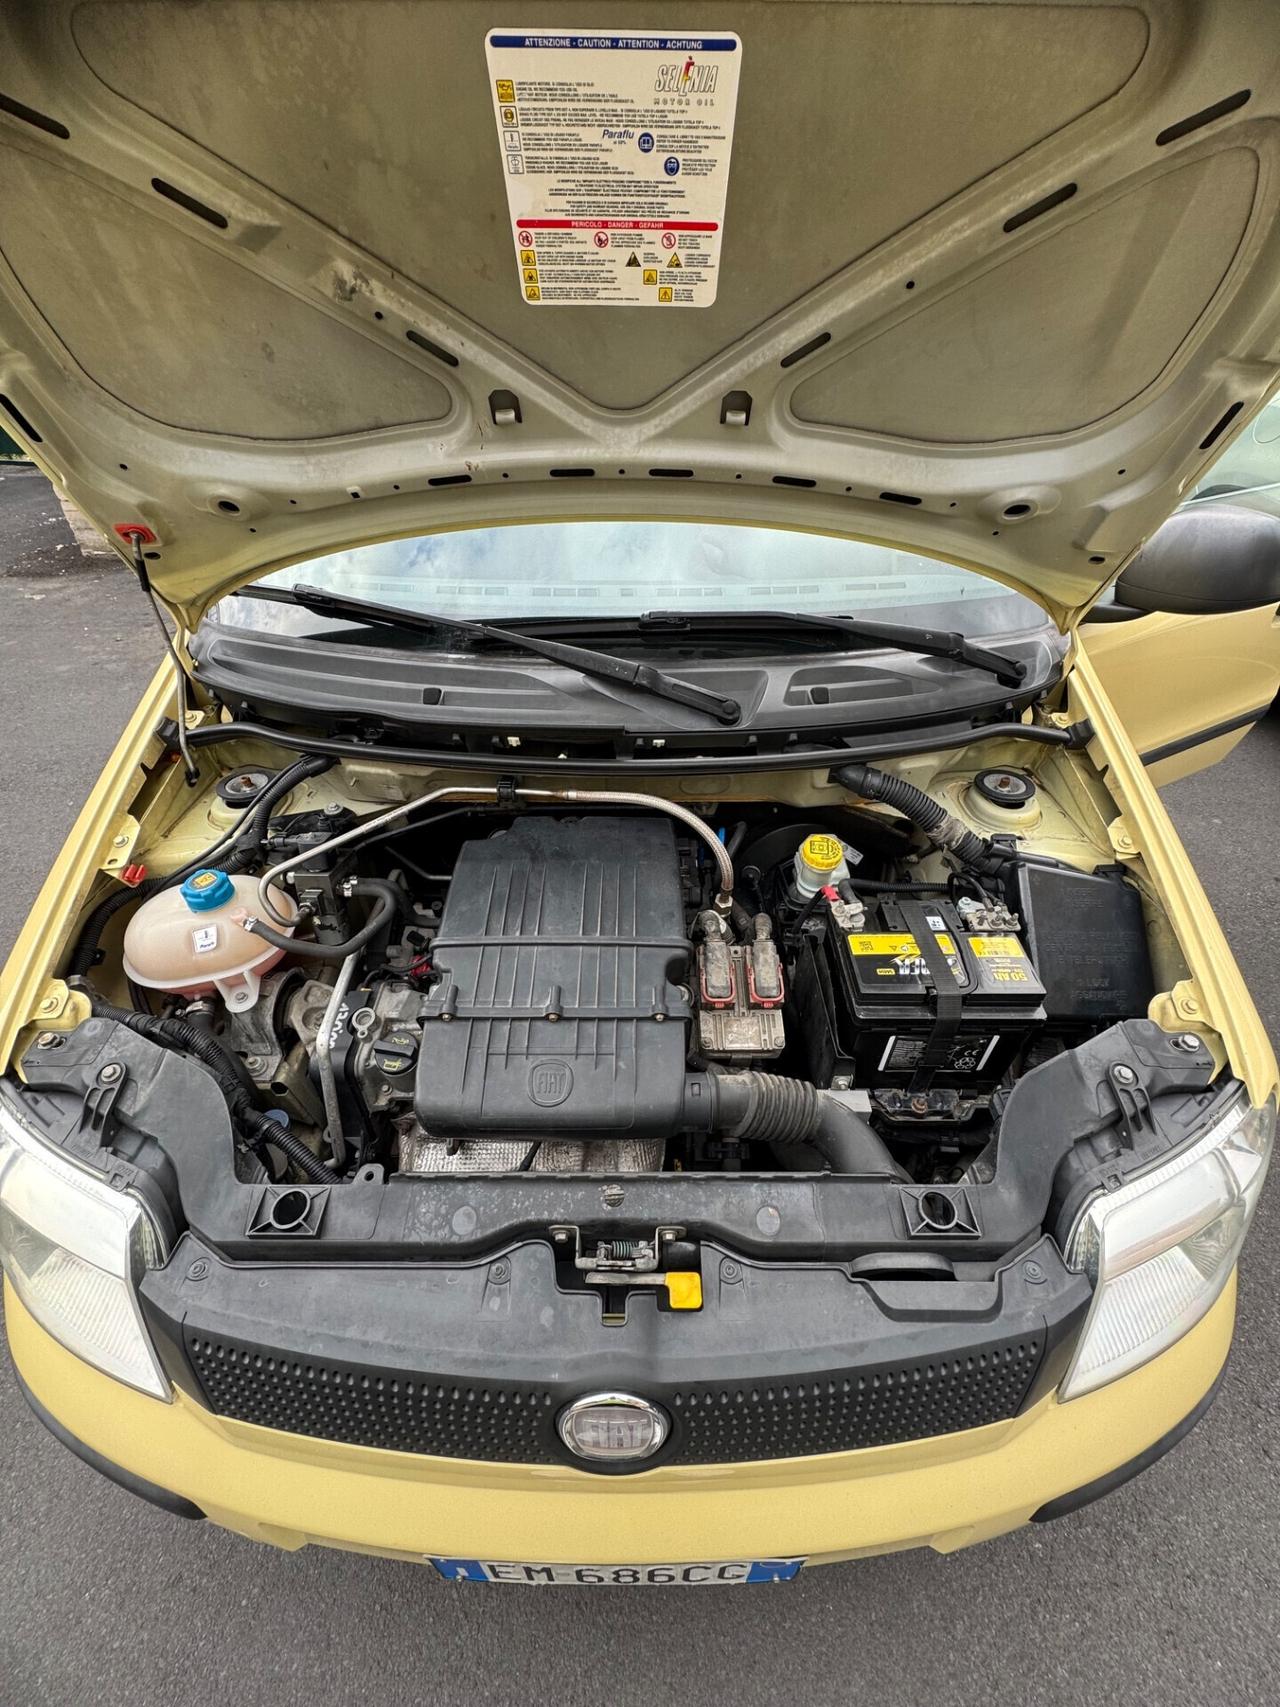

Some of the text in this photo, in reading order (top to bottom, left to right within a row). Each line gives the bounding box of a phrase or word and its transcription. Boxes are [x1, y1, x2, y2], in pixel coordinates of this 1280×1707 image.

[524, 37, 703, 50] ATTENZIONE CAUTION ATTENTION ACHTUNG
[654, 55, 719, 97] SELENIA
[696, 98, 714, 107] OIL
[602, 128, 635, 139] Paraflu
[571, 221, 664, 229] PERICOLO DANGER GEFAHR
[583, 1419, 648, 1449] FIAT
[486, 1563, 747, 1585] EM 686CG
